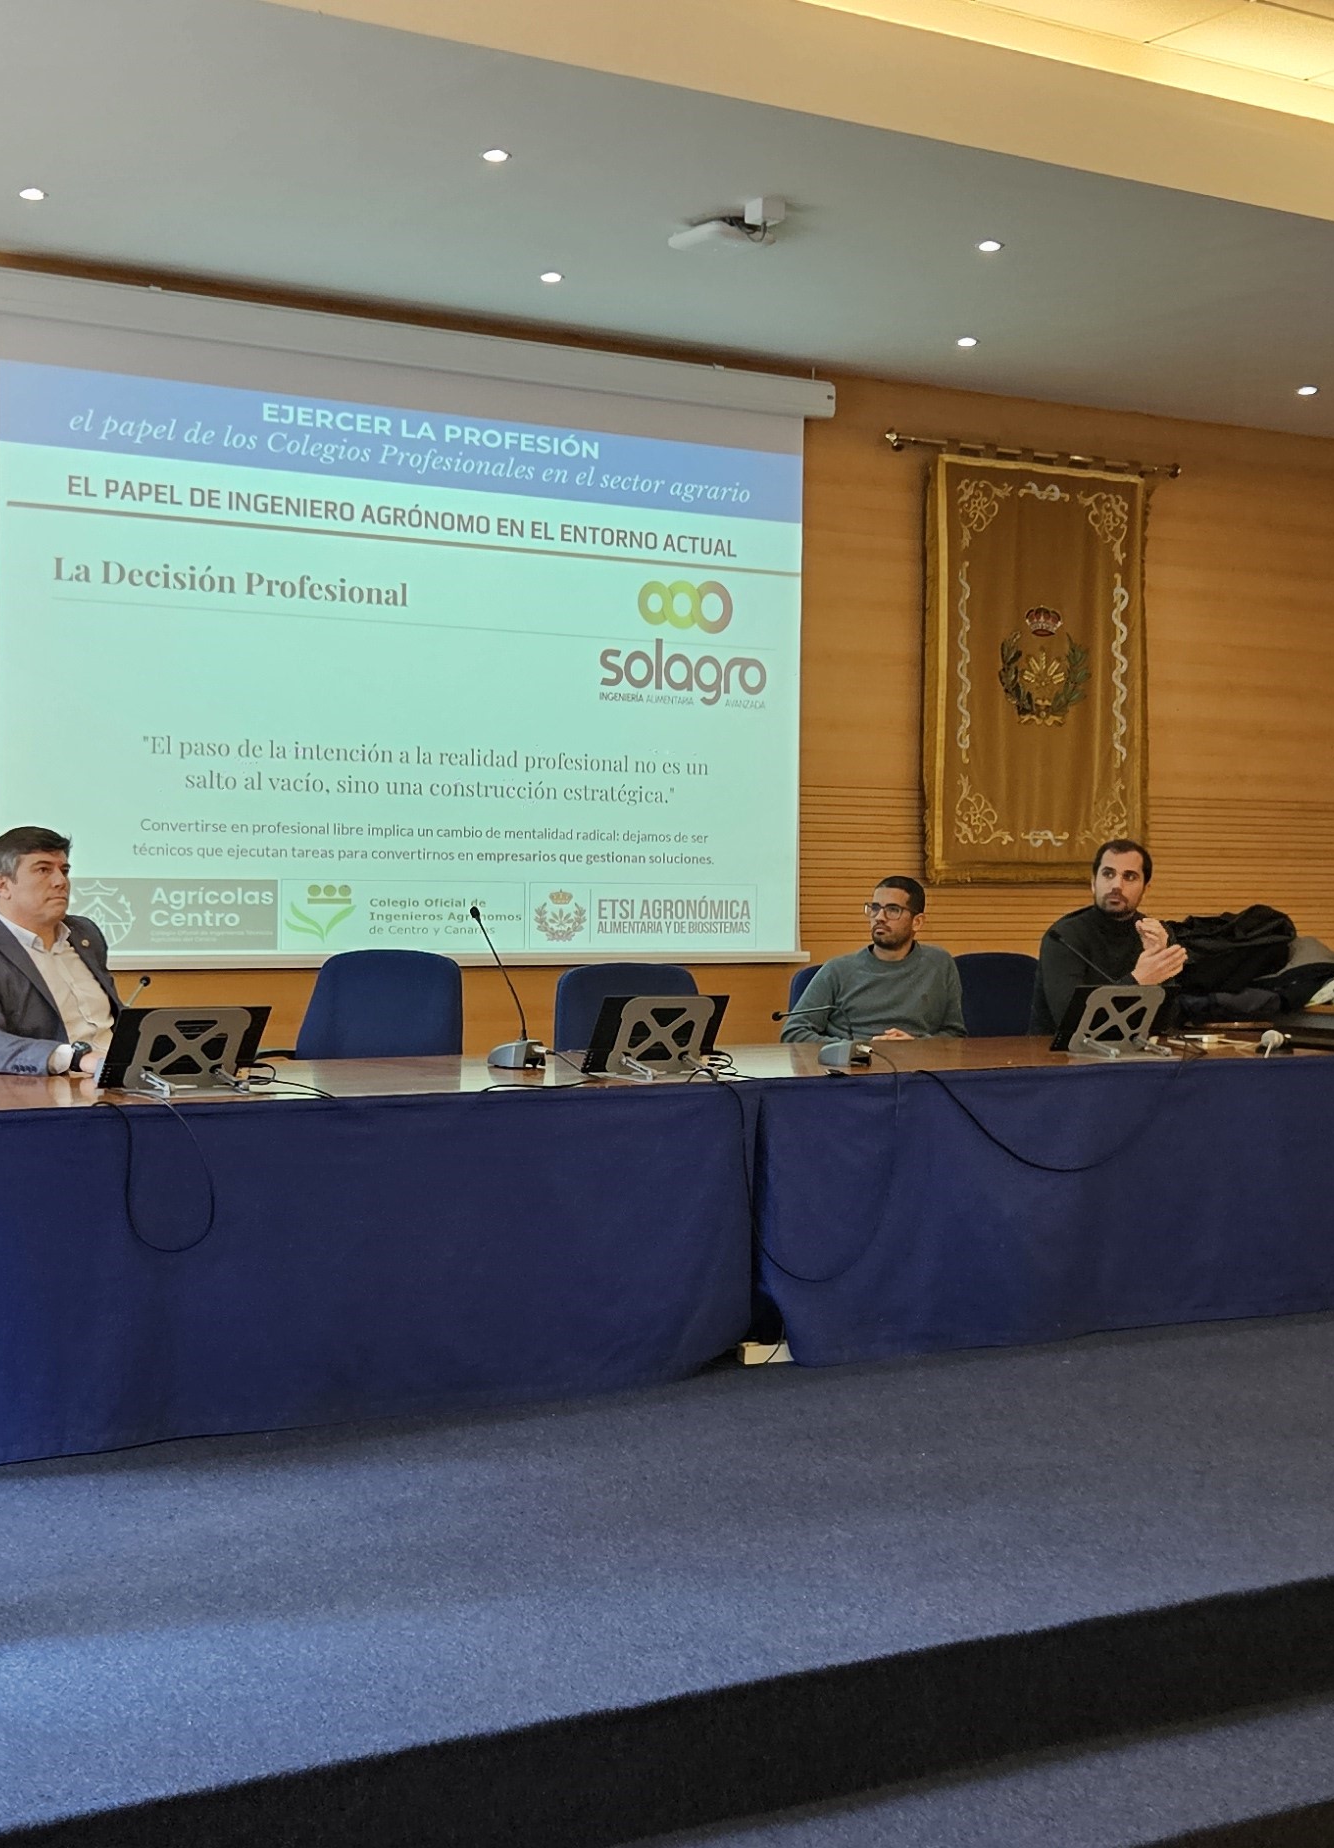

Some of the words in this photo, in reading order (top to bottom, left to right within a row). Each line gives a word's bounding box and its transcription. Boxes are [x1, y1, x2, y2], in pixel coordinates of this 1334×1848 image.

[262, 402, 392, 435] EJERCER
[401, 419, 436, 441] LA
[445, 423, 600, 460] PROFESIÓN
[70, 410, 93, 432] el
[99, 414, 176, 444] papel
[184, 422, 215, 445] de
[224, 426, 258, 450] los
[268, 432, 370, 464] Colegios
[379, 444, 534, 481] Profesionales
[542, 466, 568, 484] en
[576, 467, 595, 488] el
[600, 472, 665, 494] sector
[670, 480, 750, 504] agrario
[68, 474, 97, 498] EL
[105, 478, 182, 506] PAPEL
[190, 487, 220, 510] DE
[228, 491, 354, 522] INGENIERO
[361, 504, 490, 534] AGRÓNOMO
[496, 518, 524, 538] EN
[530, 522, 554, 541] EL
[560, 524, 658, 550] ENTORNO
[663, 534, 737, 558] ACTUAL
[53, 556, 91, 584] La
[102, 560, 236, 594] Decisión
[245, 572, 409, 607] Profesional
[600, 638, 766, 706] solagro
[599, 692, 644, 703] INGENIERÍA
[142, 735, 172, 755] "El
[179, 740, 230, 760] paso
[238, 738, 264, 758] de
[269, 740, 287, 760] la
[294, 741, 393, 764] intención
[399, 751, 410, 764] a
[416, 746, 432, 766] la
[439, 748, 518, 768] realidad
[524, 752, 630, 773] profesional
[634, 760, 656, 774] no
[662, 761, 680, 775] es
[686, 762, 709, 776] un
[184, 770, 238, 791] salto
[243, 772, 262, 792] al
[268, 772, 330, 795] vacío,
[336, 775, 379, 795] sino
[386, 781, 424, 796] una
[429, 780, 558, 801] construcción
[563, 784, 676, 806] estratégica."
[140, 818, 228, 834] Convertirse
[230, 822, 249, 834] en
[252, 820, 330, 838] profesional
[332, 822, 364, 836] libre
[367, 822, 414, 840] implica
[416, 827, 434, 838] un
[436, 826, 483, 840] cambio
[485, 826, 502, 840] de
[504, 827, 574, 842] mentalidad
[576, 828, 620, 843] radical:
[622, 829, 672, 845] dejamos
[674, 830, 689, 844] de
[690, 832, 708, 844] ser
[132, 842, 194, 858] técnicos
[196, 845, 224, 860] que
[226, 844, 288, 860] ejecutan
[290, 846, 334, 860] tareas
[337, 848, 368, 862] para
[370, 847, 455, 862] convertirnos
[457, 851, 474, 862] en
[476, 850, 557, 865] empresarios
[559, 853, 583, 866] que
[585, 851, 646, 866] gestionan
[648, 852, 714, 866] soluciones.
[150, 887, 274, 910] Agrícolas
[370, 898, 420, 909] Colegio
[424, 897, 466, 908] Oficial
[470, 899, 486, 908] de
[598, 898, 634, 920] ETSI
[640, 895, 750, 920] AGRONÓMICA
[150, 910, 240, 927] Centro
[370, 911, 443, 923] Ingenieros
[448, 912, 522, 924] Agrnomos
[597, 921, 662, 934] ALIMENTARIA
[665, 922, 672, 934] Y
[674, 922, 686, 934] DE
[688, 921, 750, 934] BIOSISTEMAS
[369, 925, 384, 935] de
[388, 925, 429, 936] Centro
[434, 927, 440, 937] y
